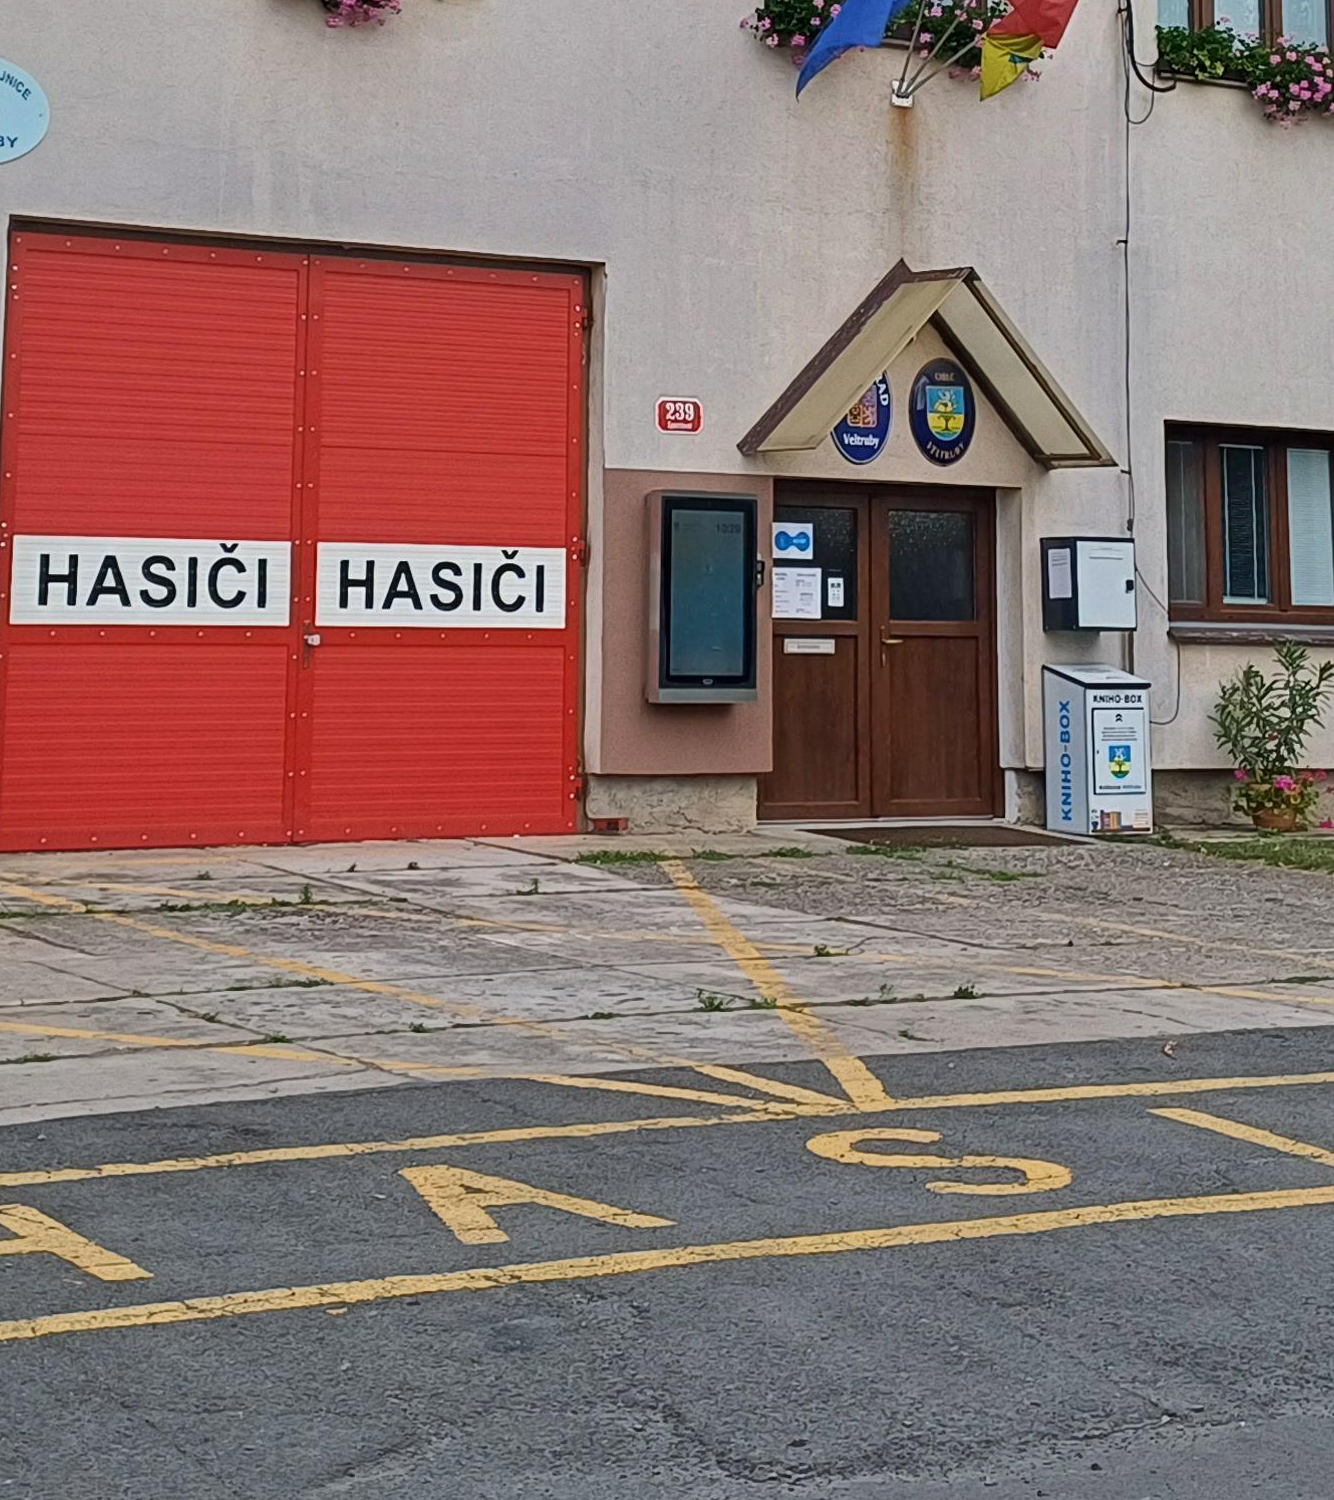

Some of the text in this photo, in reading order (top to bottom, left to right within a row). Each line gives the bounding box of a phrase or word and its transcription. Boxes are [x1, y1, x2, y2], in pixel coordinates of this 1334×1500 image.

[665, 402, 695, 421] 239
[843, 433, 880, 449] Veltruby
[38, 543, 268, 609] HASIČI
[340, 550, 545, 613] HASIČI
[1092, 694, 1143, 704] KNIHO-BOX
[1058, 700, 1073, 821] KNIHO-BOX
